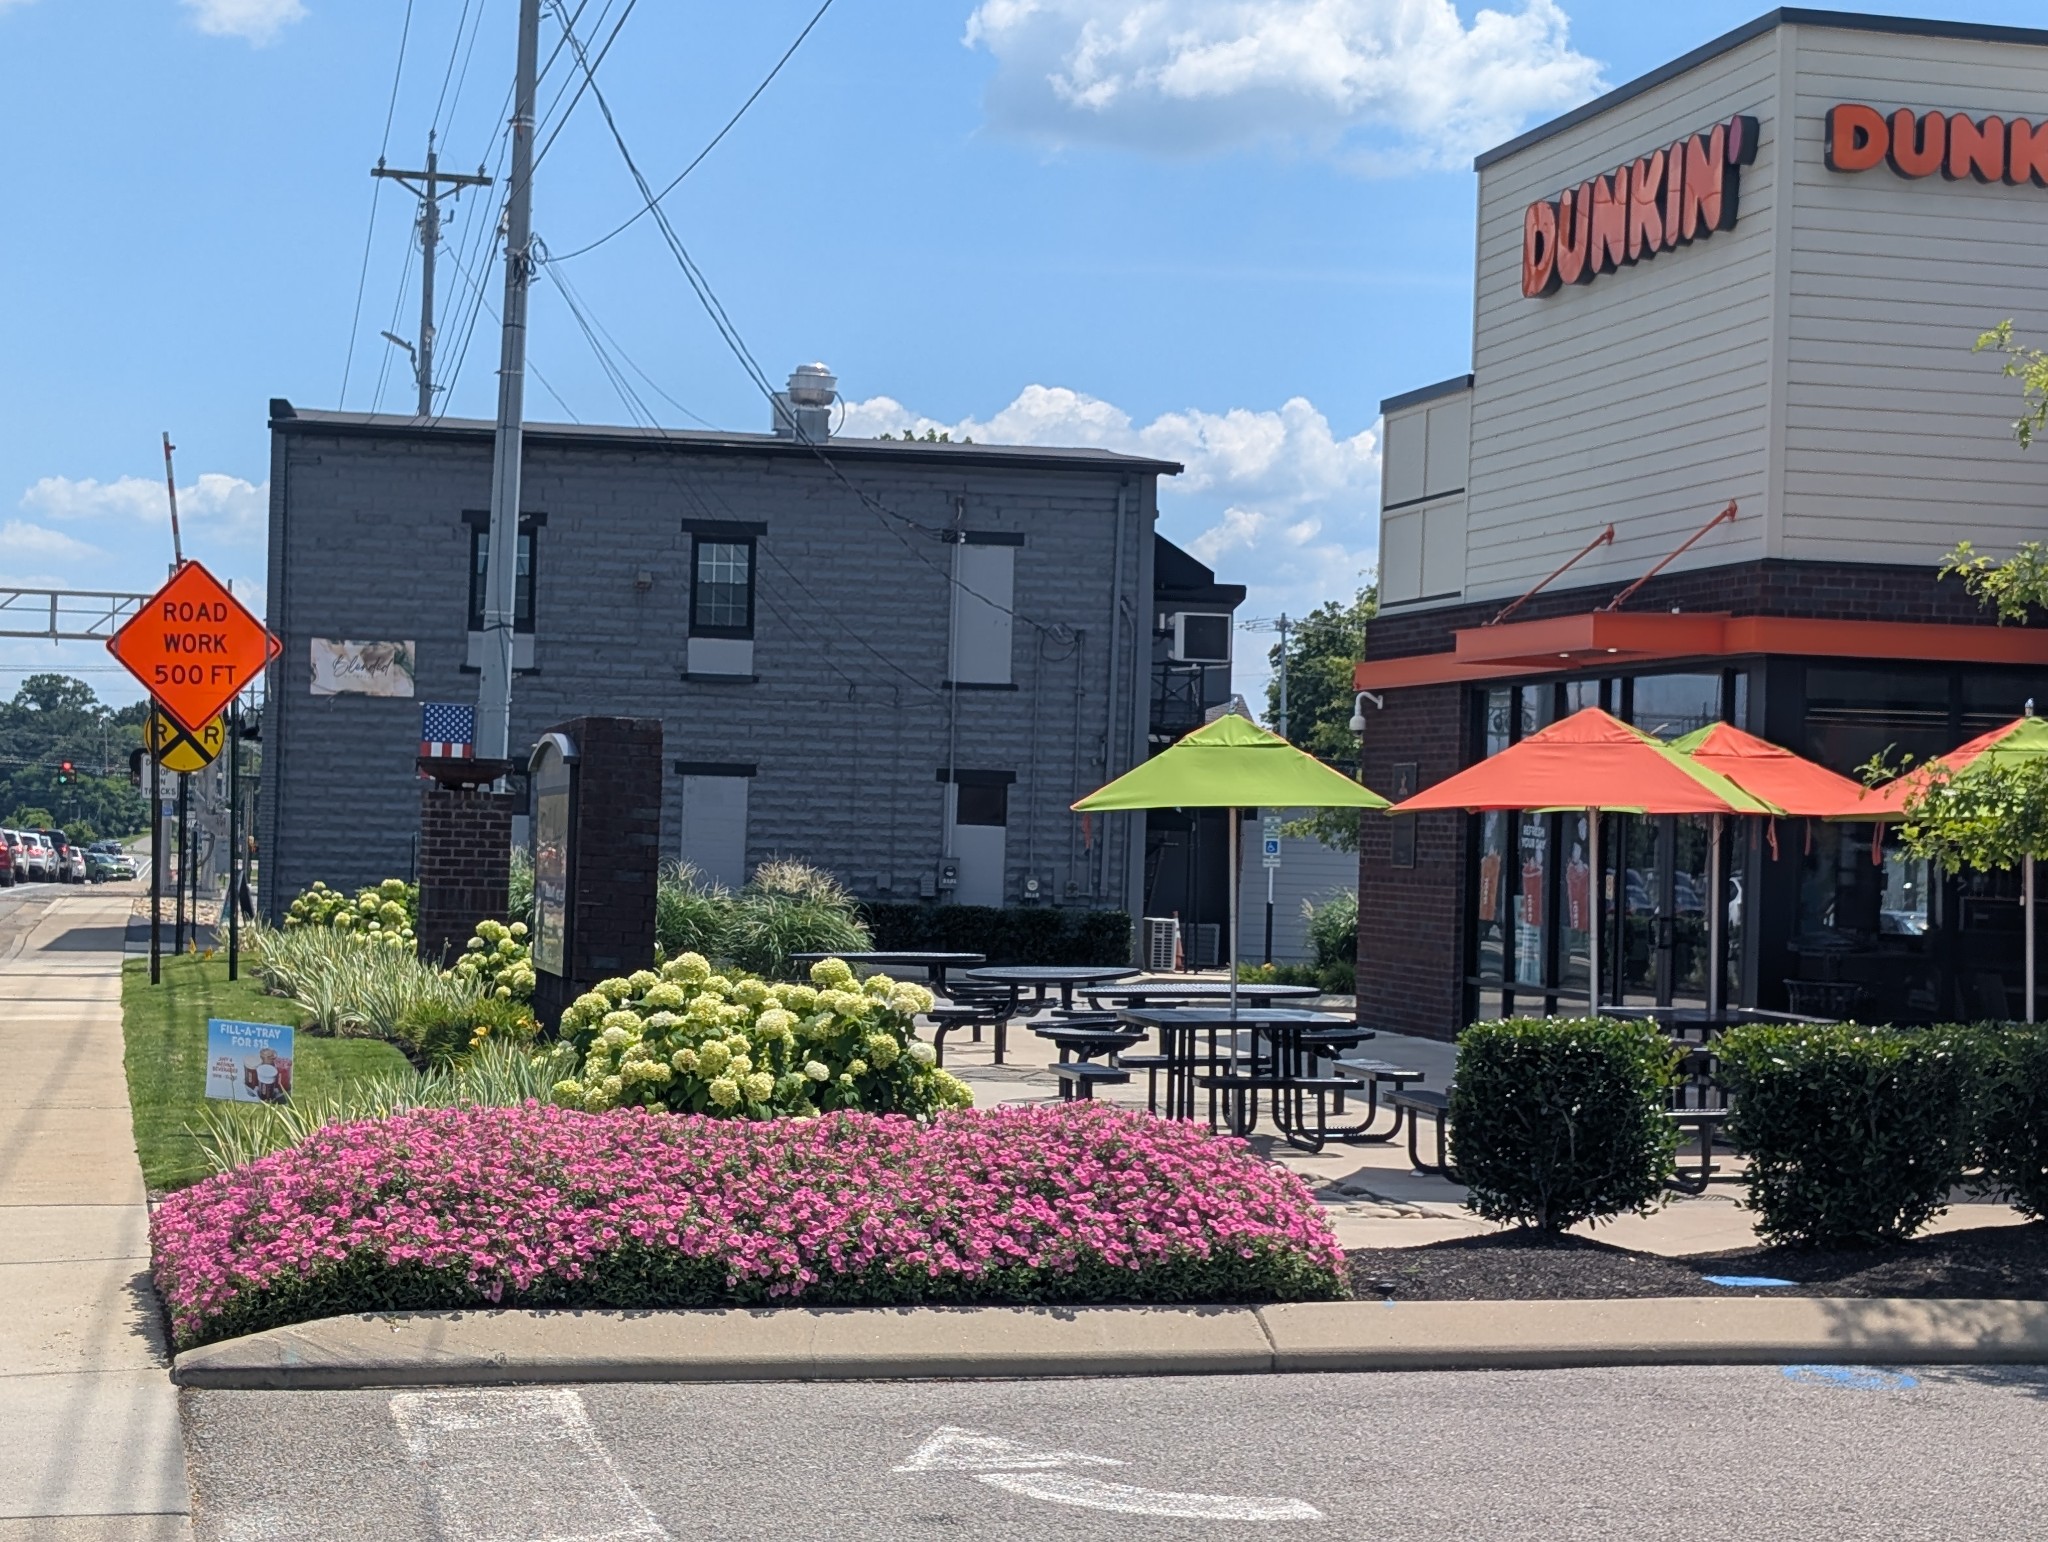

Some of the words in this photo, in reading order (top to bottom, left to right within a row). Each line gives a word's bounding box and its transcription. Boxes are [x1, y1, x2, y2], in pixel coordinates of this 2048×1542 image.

[1522, 114, 1758, 298] DUNKIN'
[163, 602, 228, 622] ROAD
[163, 633, 228, 654] WORK
[155, 664, 203, 685] 500
[211, 664, 237, 685] FT
[203, 725, 220, 745] R
[220, 1023, 282, 1039] FILL-A-TRAY
[231, 1036, 252, 1048] FOR
[253, 1038, 269, 1049] $15
